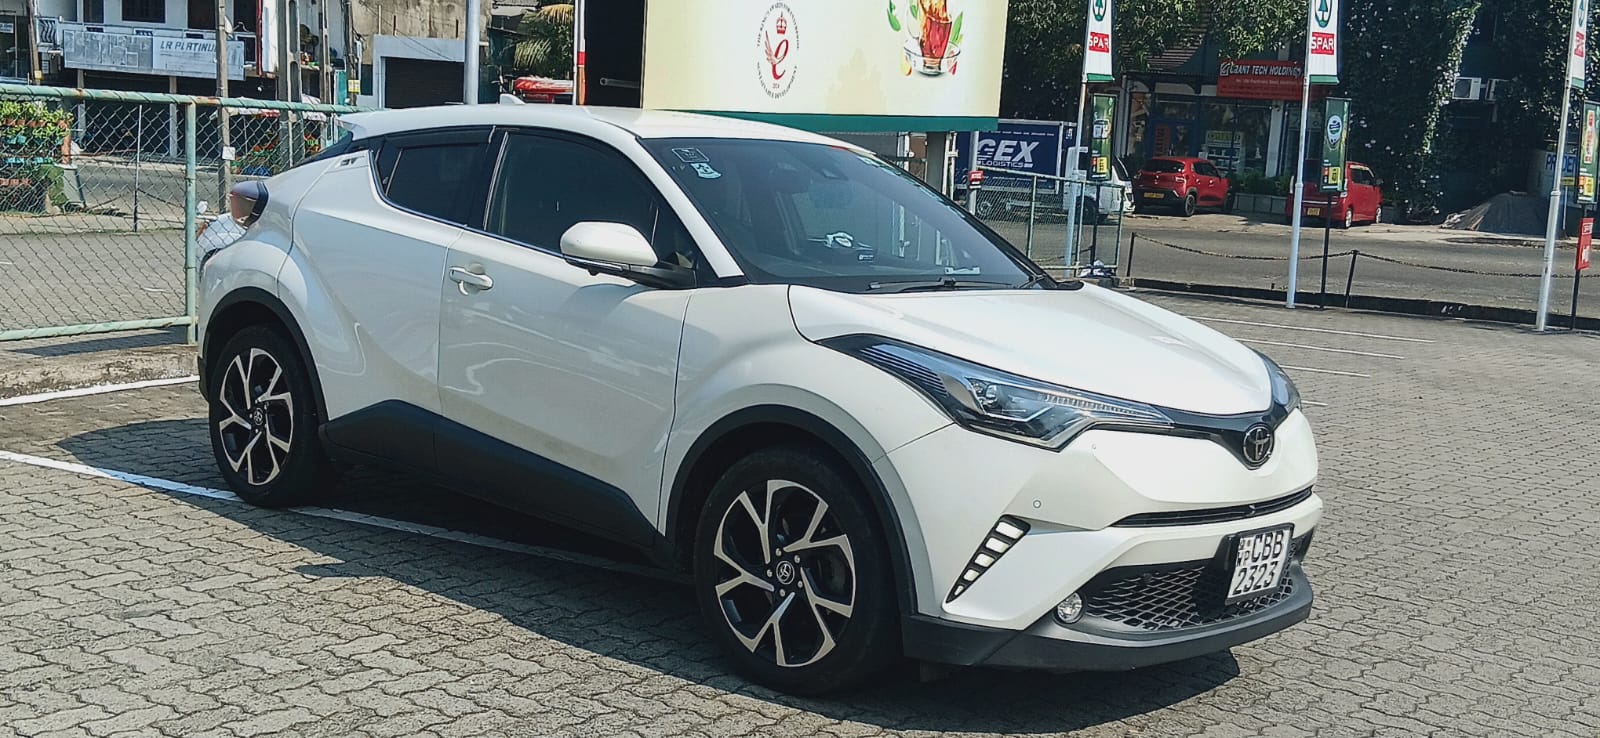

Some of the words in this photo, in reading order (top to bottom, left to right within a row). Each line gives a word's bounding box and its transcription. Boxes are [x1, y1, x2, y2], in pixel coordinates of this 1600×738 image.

[160, 41, 173, 49] LR
[175, 42, 216, 52] PLATINU
[1089, 36, 1109, 49] SPAR
[1311, 37, 1334, 51] SPAR
[1252, 66, 1268, 75] TECH
[981, 160, 1024, 168] LOGISTICS
[1252, 530, 1284, 562] CBB
[1232, 561, 1279, 596] 2323
